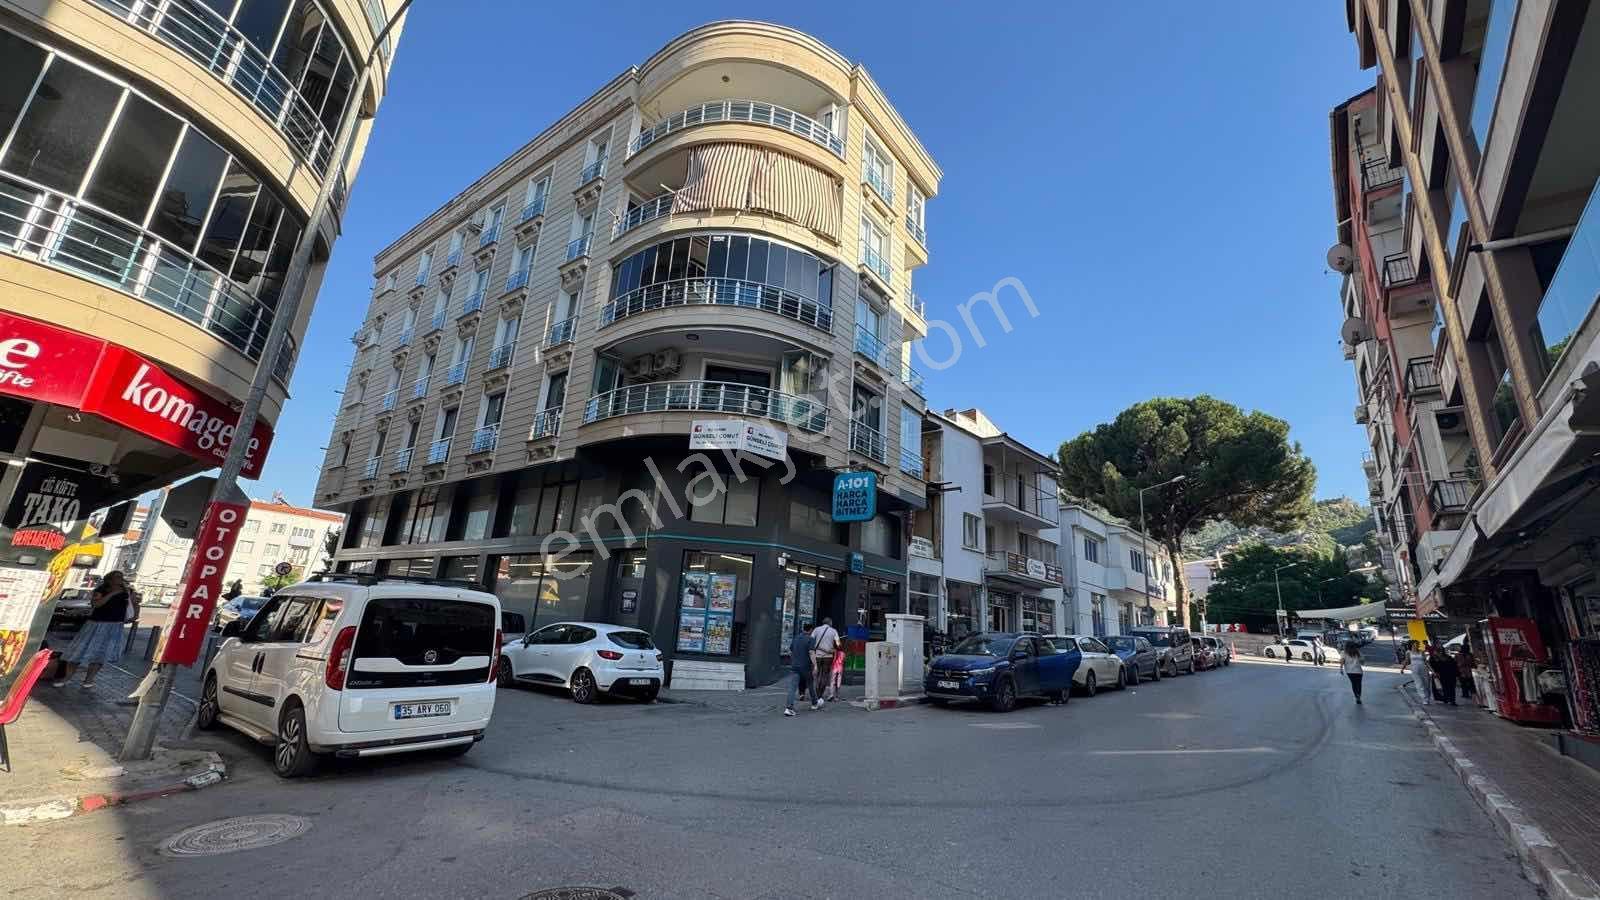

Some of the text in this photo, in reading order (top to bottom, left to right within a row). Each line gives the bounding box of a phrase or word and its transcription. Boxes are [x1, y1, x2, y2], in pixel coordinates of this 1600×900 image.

[121, 363, 260, 458] komagee
[837, 490, 868, 499] HARCA
[836, 498, 868, 507] HARCA
[16, 492, 81, 534] TAKO
[401, 703, 413, 715] 35
[417, 701, 431, 714] ARV
